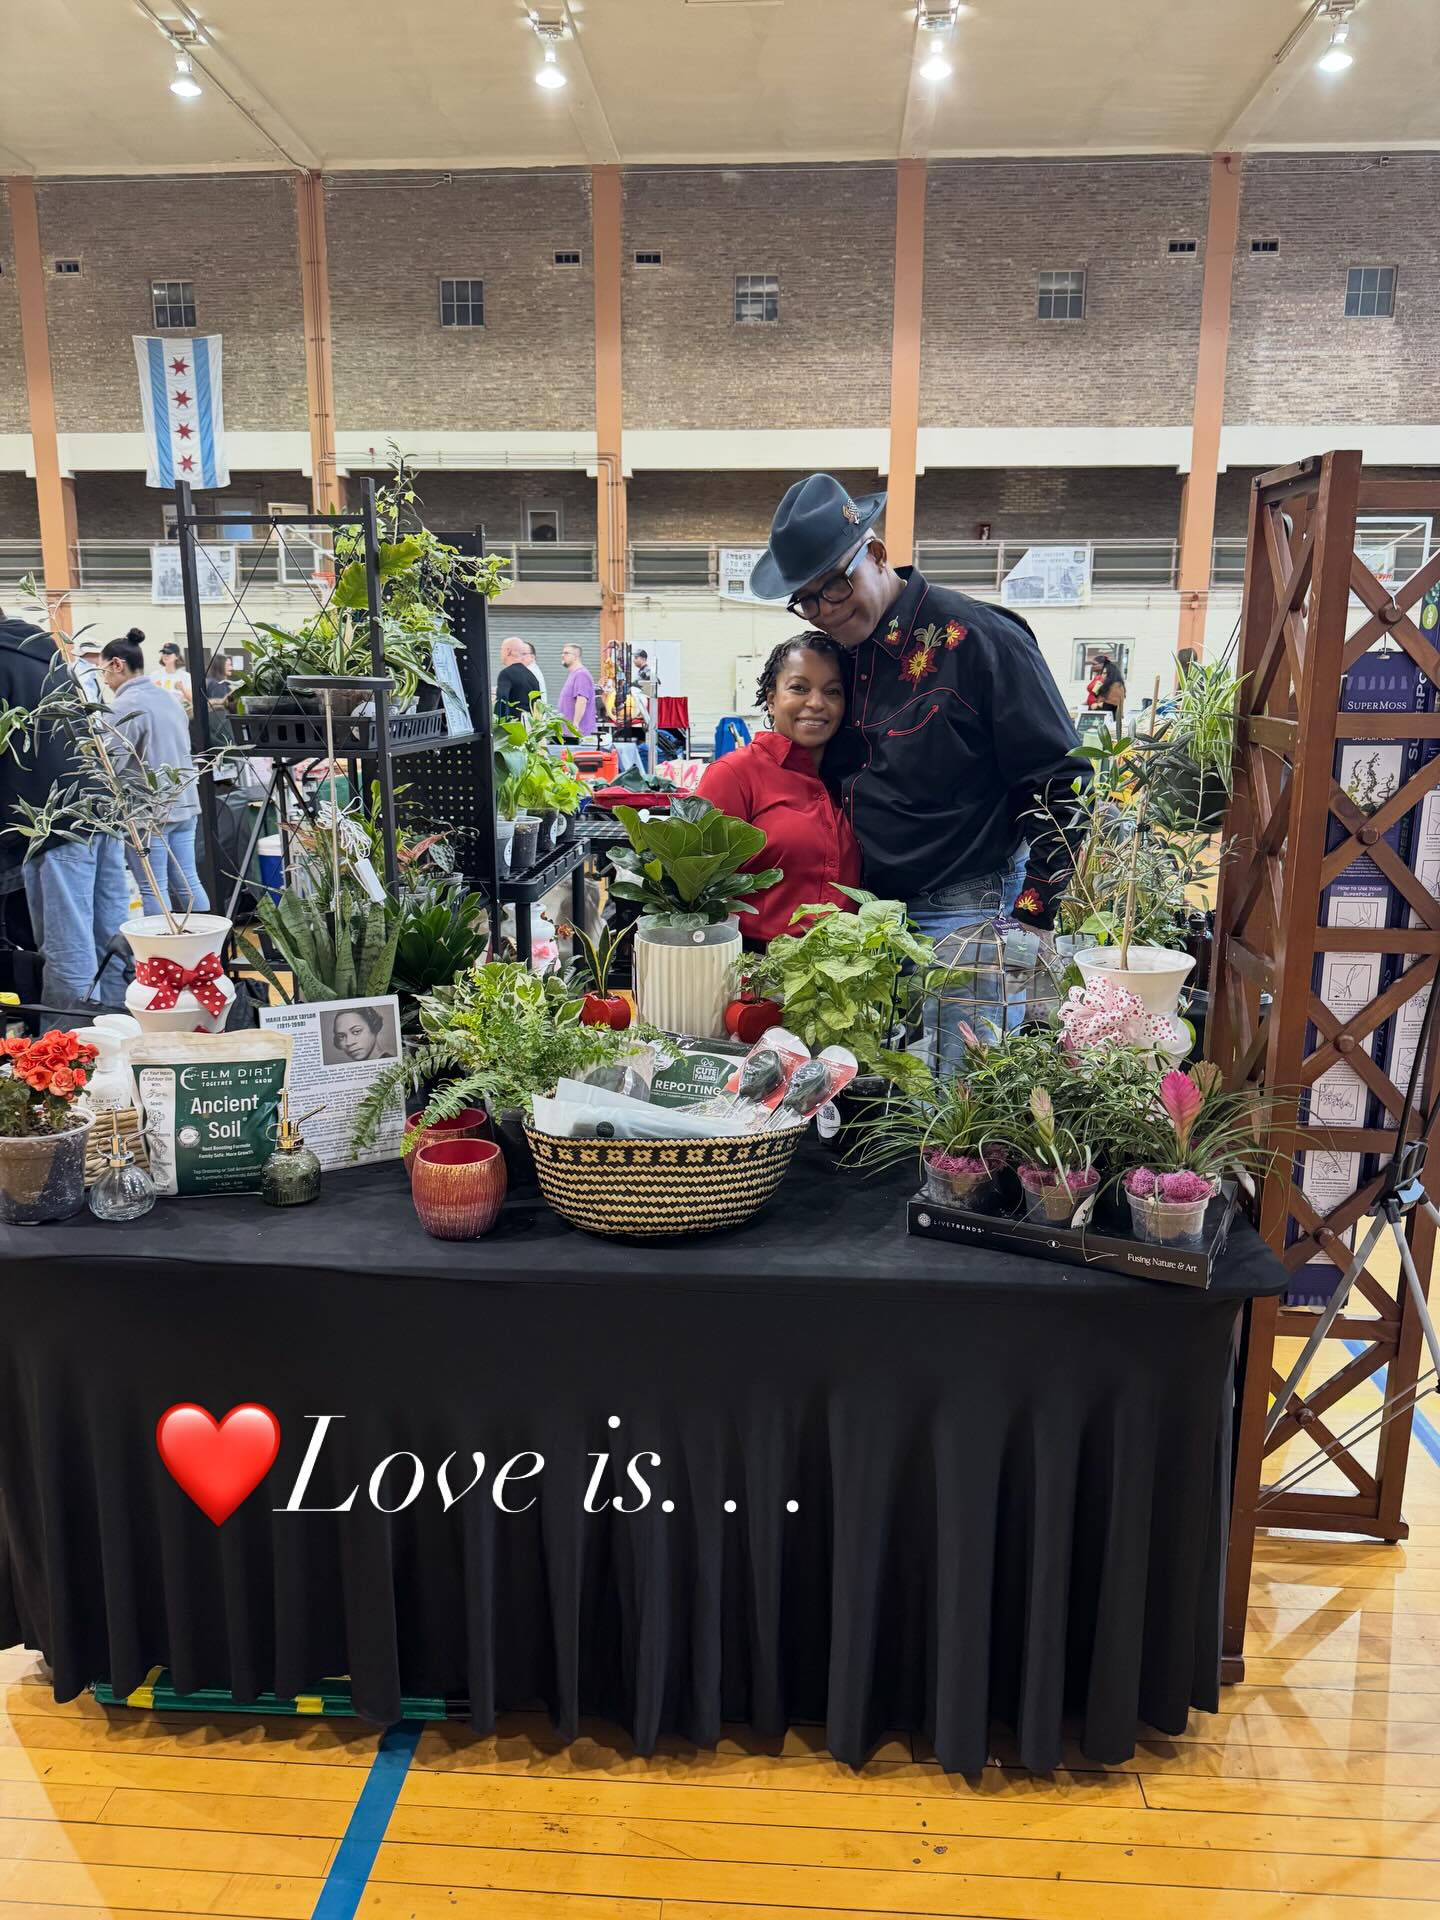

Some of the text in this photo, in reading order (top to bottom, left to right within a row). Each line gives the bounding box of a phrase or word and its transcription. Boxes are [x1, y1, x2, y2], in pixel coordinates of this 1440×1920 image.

[299, 1012, 317, 1020] TAYLOR
[201, 1067, 273, 1080] ELM DIRT
[695, 1066, 717, 1077] CUTE
[655, 1080, 721, 1096] REPOTTING
[190, 1094, 260, 1115] Ancient
[208, 1120, 241, 1139] Soil
[1127, 1253, 1198, 1273] Fusing Nature & Art
